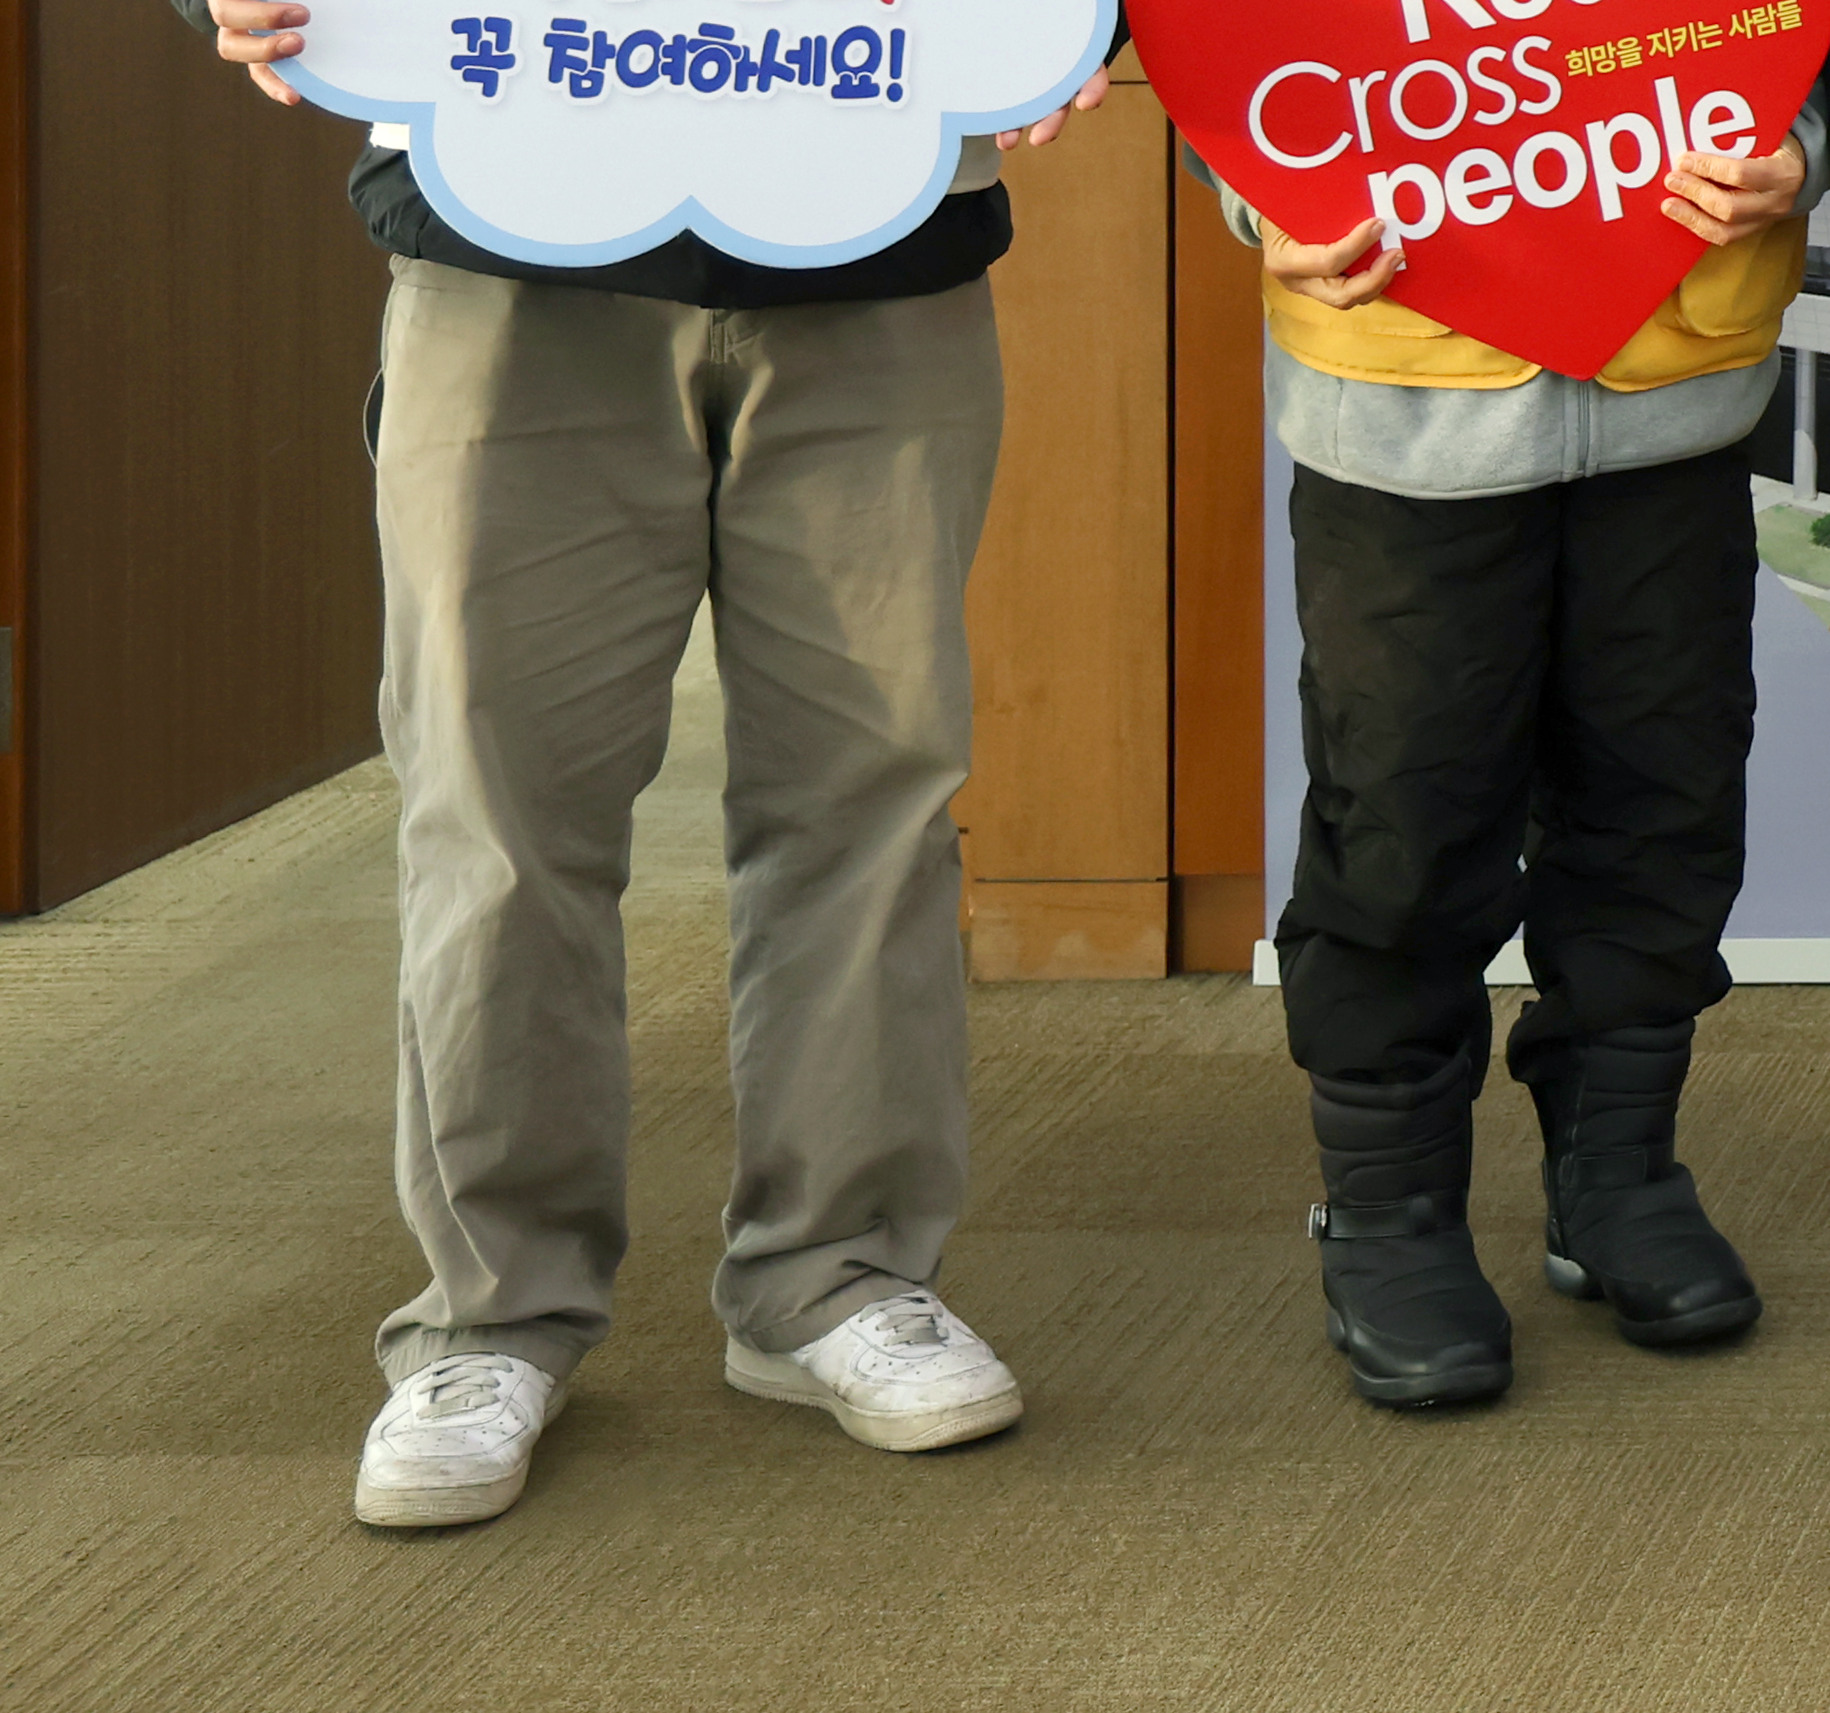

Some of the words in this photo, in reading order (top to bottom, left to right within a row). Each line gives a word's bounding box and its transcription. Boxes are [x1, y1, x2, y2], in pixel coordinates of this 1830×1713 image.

[451, 18, 516, 97] 꼭
[545, 18, 904, 100] 참여하세요!
[1248, 35, 1561, 168] Cross
[1565, 35, 1642, 80] 희망을
[1648, 19, 1722, 60] 지키는
[1368, 75, 1756, 271] people
